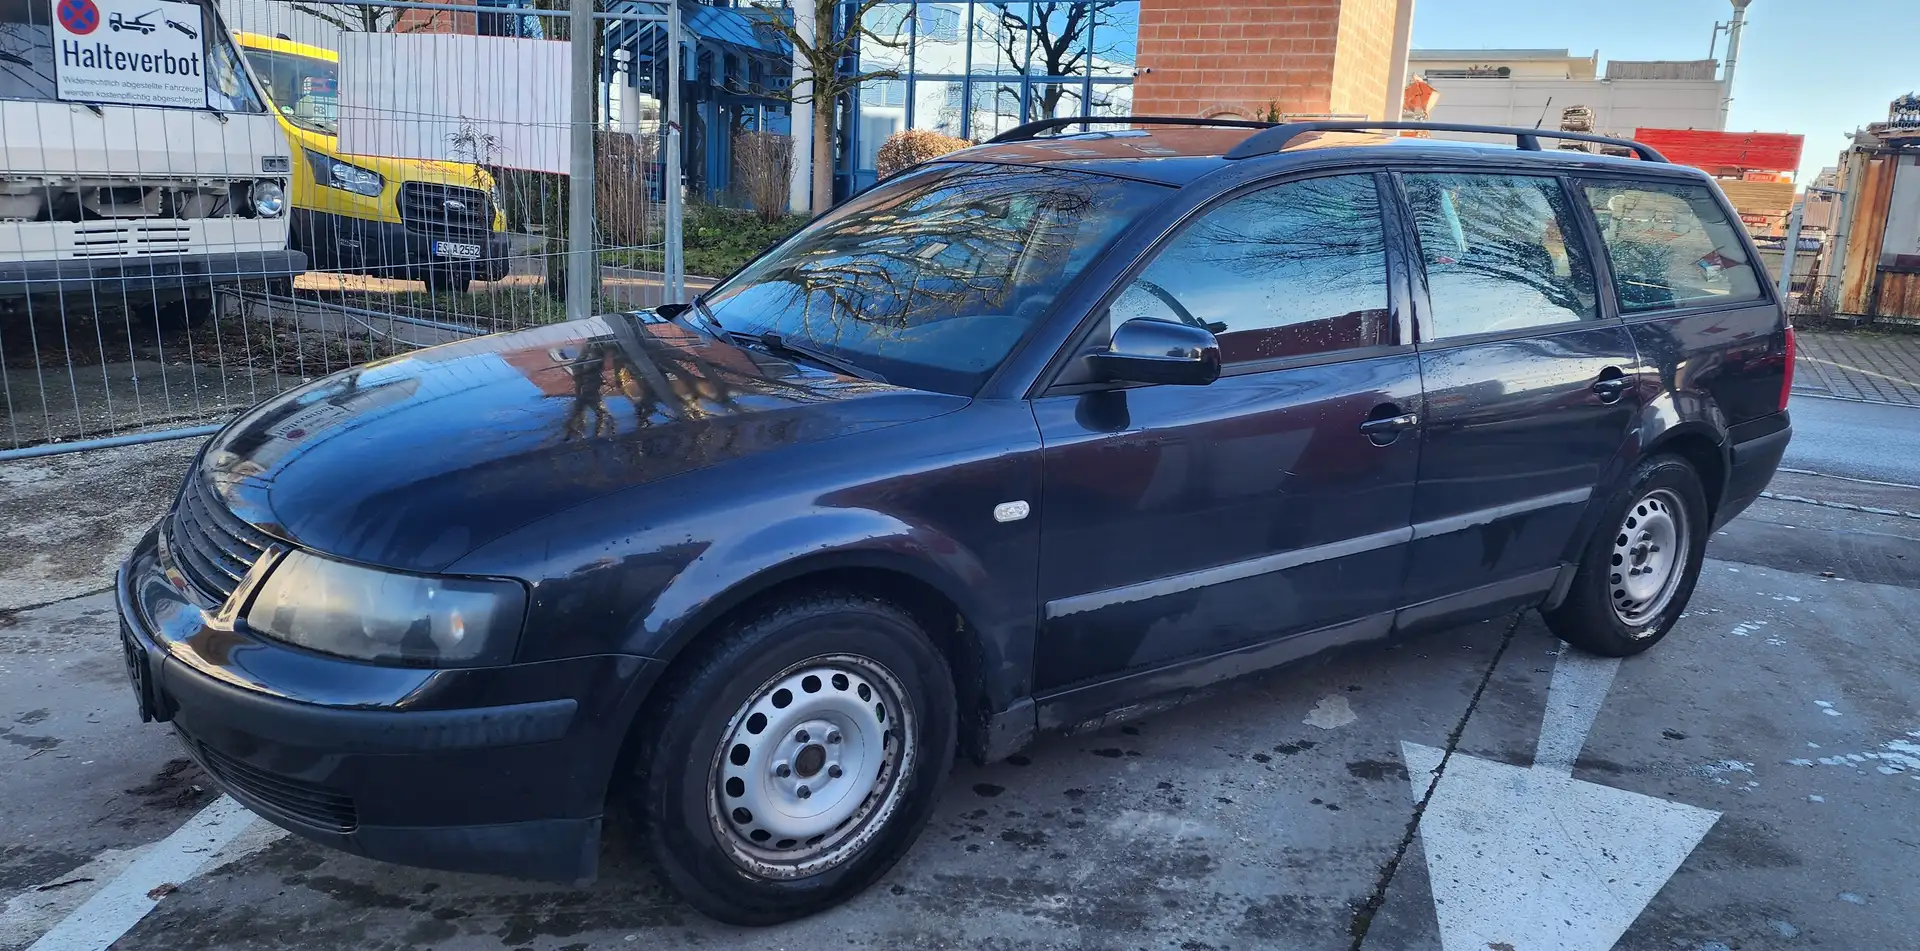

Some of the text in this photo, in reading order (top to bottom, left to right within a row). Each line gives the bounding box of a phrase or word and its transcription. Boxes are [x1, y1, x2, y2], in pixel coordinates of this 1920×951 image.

[63, 39, 200, 77] Halteverbot
[121, 80, 163, 90] abgestellte
[164, 83, 203, 93] Fahrzeuge
[63, 89, 203, 105] werden kostenpflichtig abgeschleppt!
